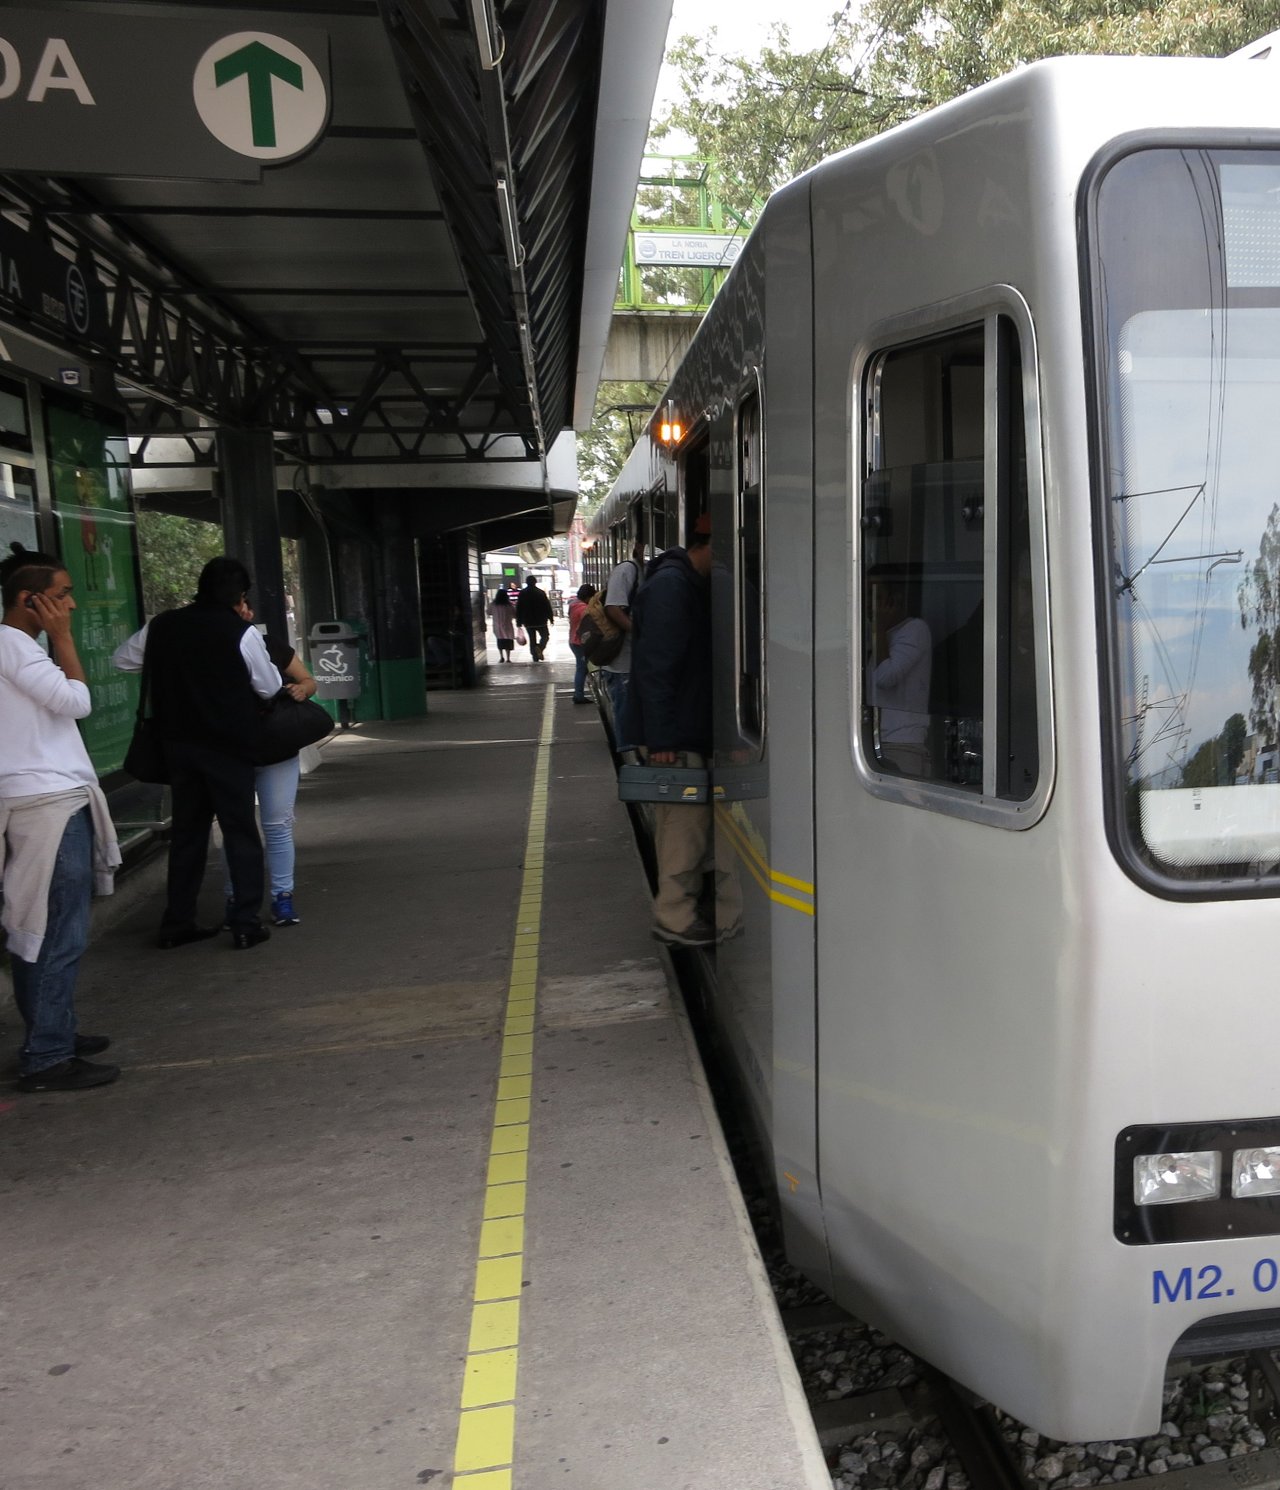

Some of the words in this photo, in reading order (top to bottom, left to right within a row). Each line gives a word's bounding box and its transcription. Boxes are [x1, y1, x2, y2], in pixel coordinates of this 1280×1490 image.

[658, 250, 684, 259] TREN
[687, 251, 722, 260] LIGERO
[1152, 1265, 1235, 1305] M2.
